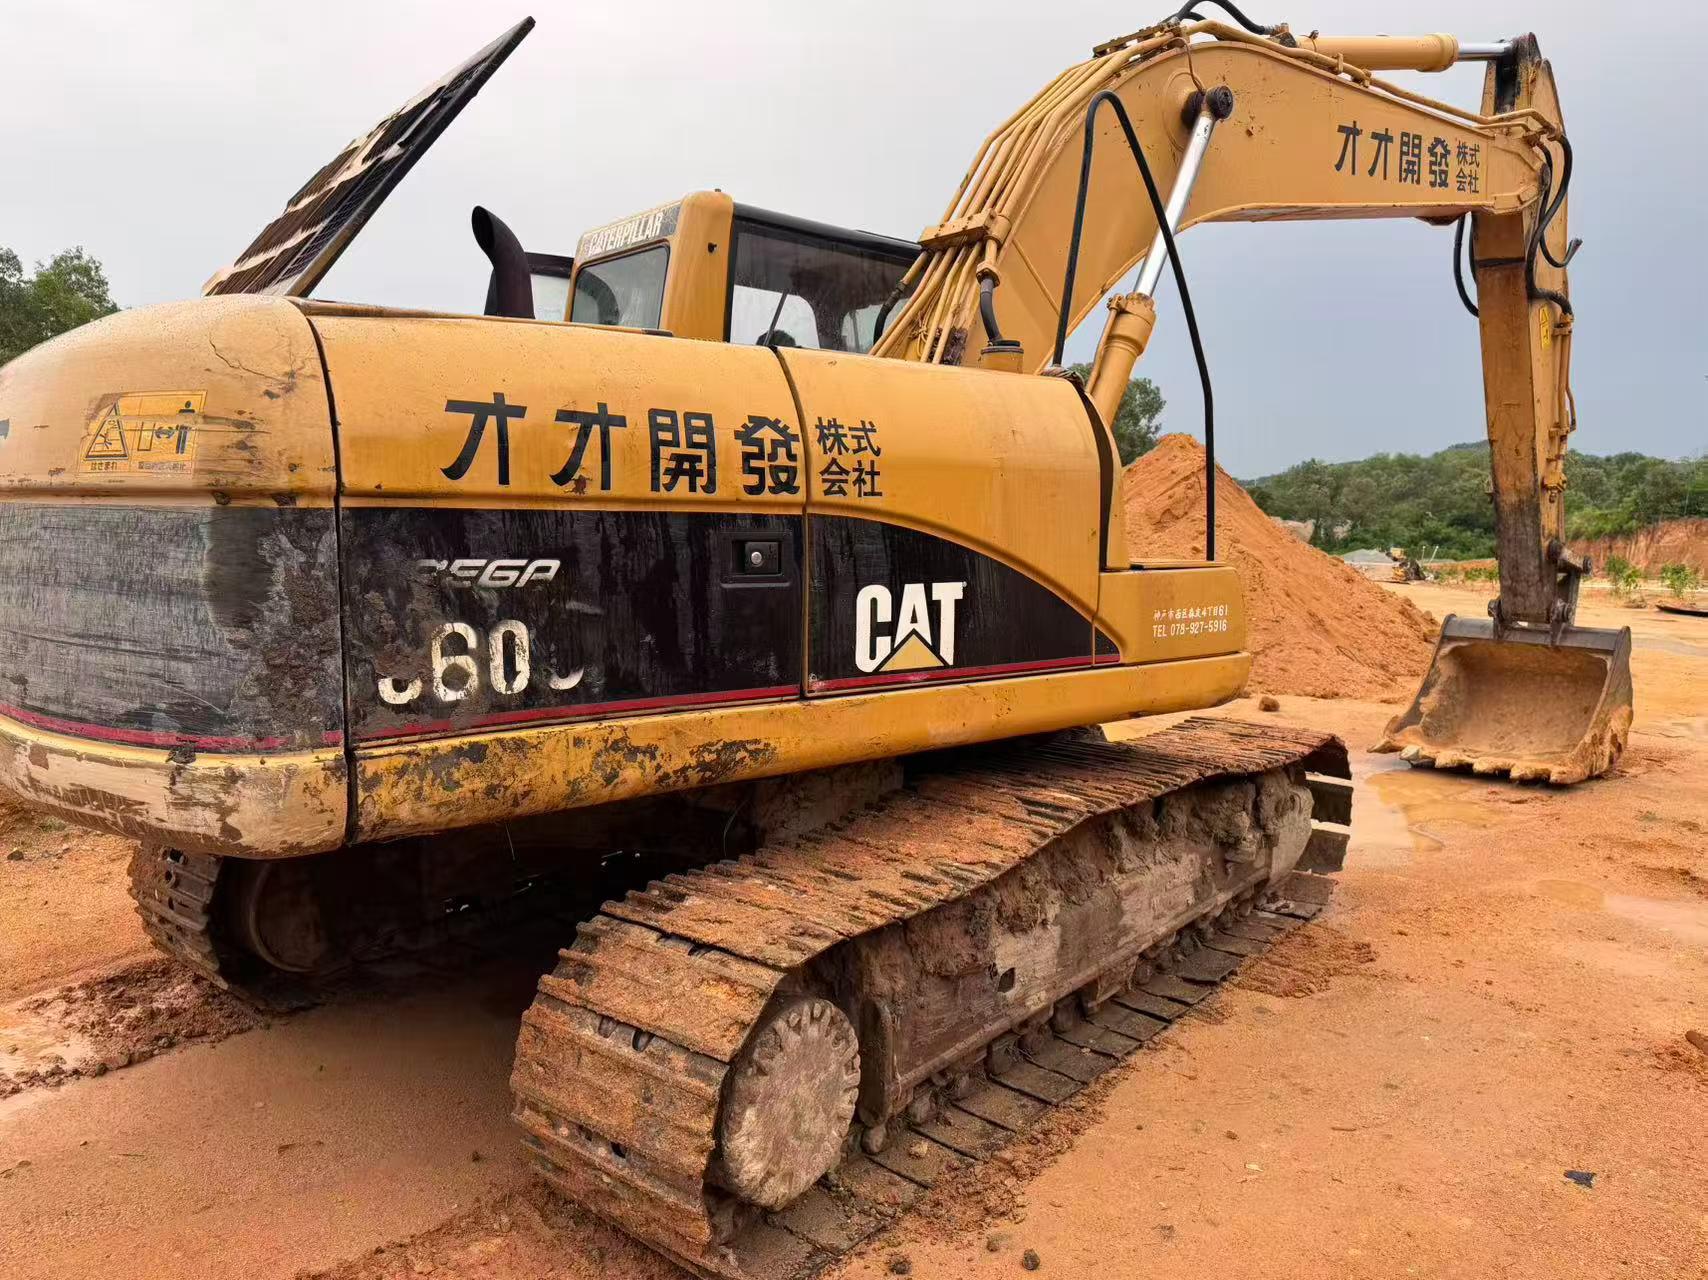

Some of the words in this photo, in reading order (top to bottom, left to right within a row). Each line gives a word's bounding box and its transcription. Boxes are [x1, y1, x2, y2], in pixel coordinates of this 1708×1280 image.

[1456, 140, 1480, 168] 株式
[1455, 168, 1480, 194] 会社
[587, 212, 664, 257] CATERPILLAR
[816, 416, 881, 457] 株式
[818, 458, 883, 497] 会社
[855, 582, 964, 673] CAT
[1152, 624, 1168, 638] TEL
[1170, 619, 1227, 636] 078-927-5916
